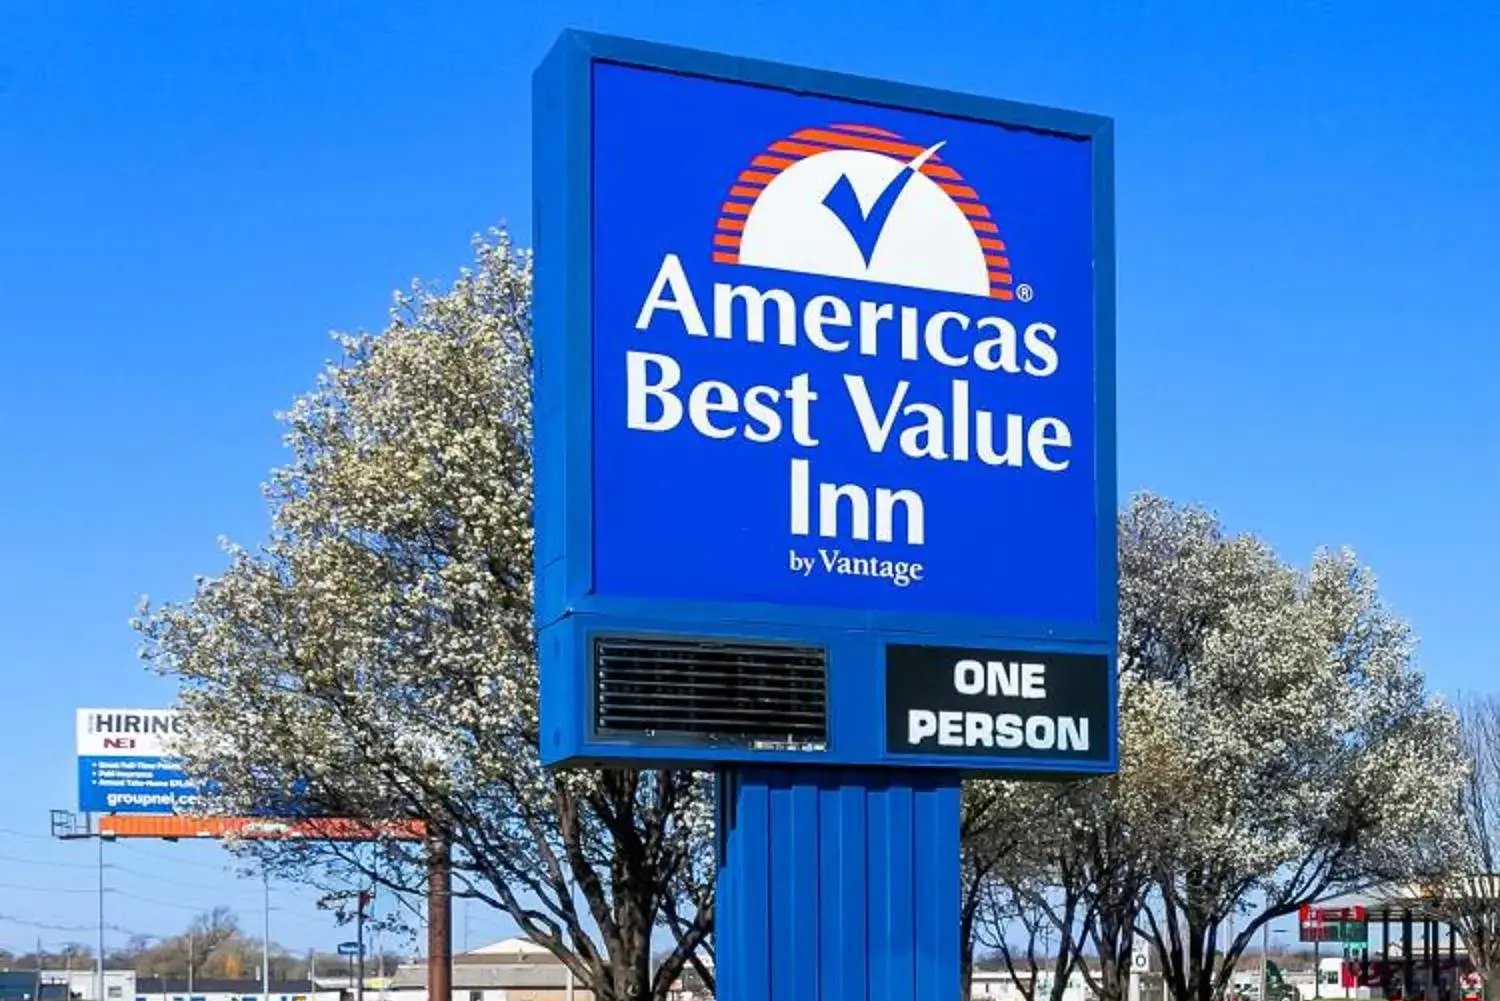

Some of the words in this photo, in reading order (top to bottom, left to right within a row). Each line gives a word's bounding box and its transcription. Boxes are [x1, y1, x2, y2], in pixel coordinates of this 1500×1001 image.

[635, 253, 1060, 377] Americas
[626, 350, 819, 447] Best
[843, 374, 1072, 472] Value
[790, 458, 925, 546] Inn
[789, 549, 815, 577] by
[818, 548, 924, 587] Vantage
[953, 659, 1047, 699] ONE
[908, 709, 1090, 751] PERSON
